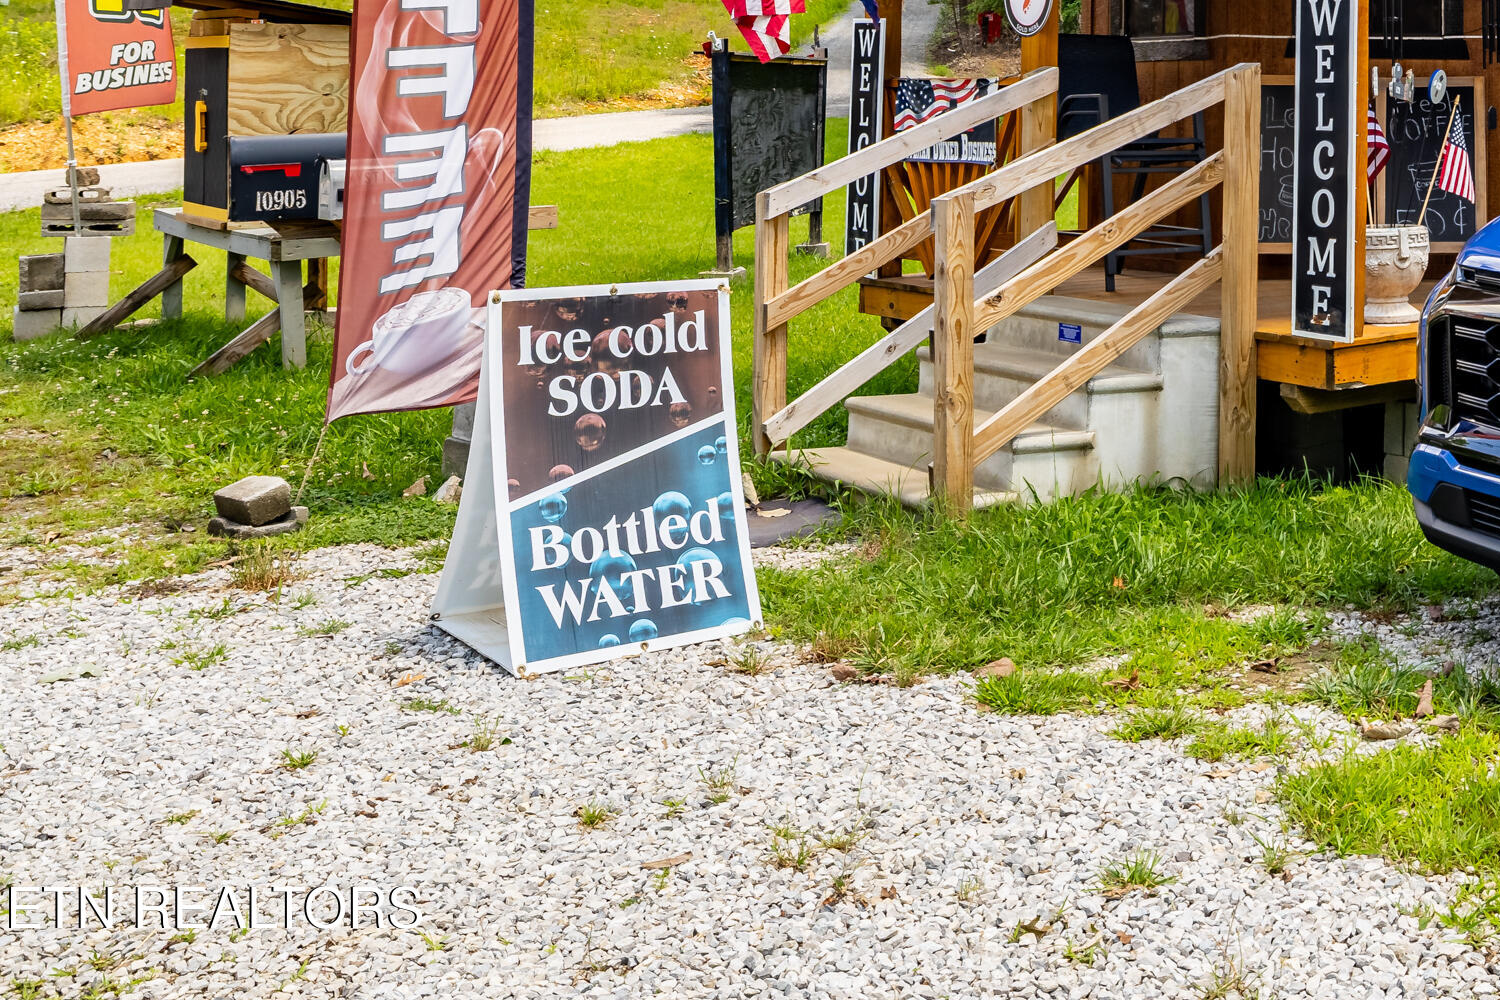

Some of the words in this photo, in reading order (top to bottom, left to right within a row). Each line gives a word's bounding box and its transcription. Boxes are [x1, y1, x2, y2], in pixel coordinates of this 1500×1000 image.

[1016, 23, 1028, 33] SOLD
[1028, 23, 1040, 33] HERE
[109, 40, 156, 66] FOR
[74, 61, 173, 95] BUSINESS
[1390, 114, 1472, 143] COFFE
[933, 141, 959, 160] OWNED
[256, 189, 307, 212] 10905
[517, 323, 592, 366] Ice
[608, 310, 709, 358] cold
[547, 366, 688, 417] SODA
[528, 497, 726, 572] Bottled
[535, 557, 733, 631] WATER
